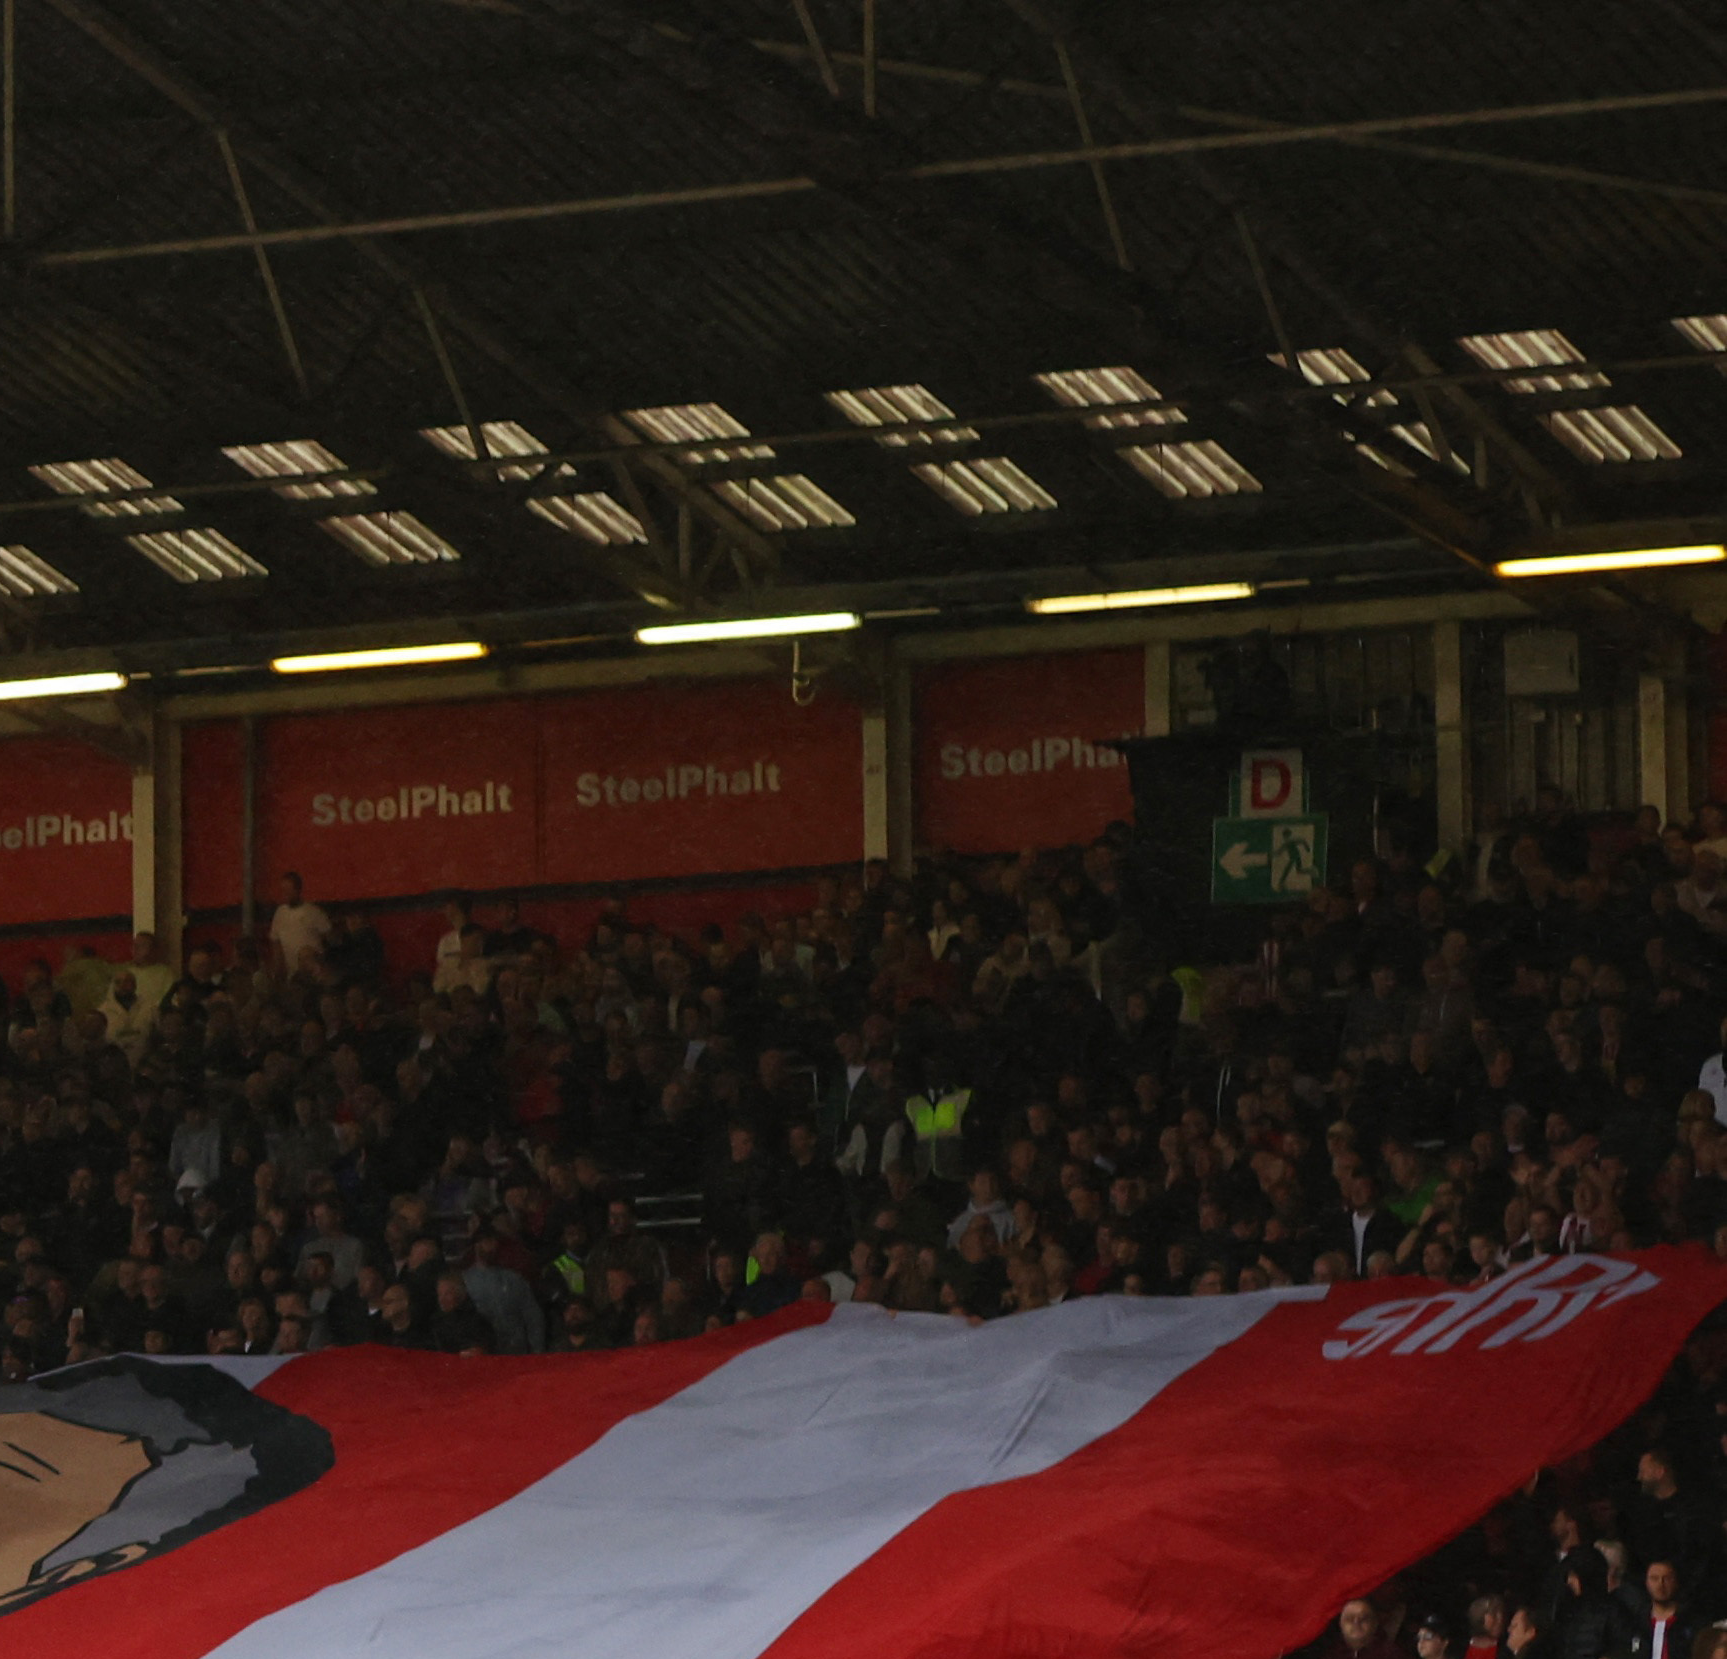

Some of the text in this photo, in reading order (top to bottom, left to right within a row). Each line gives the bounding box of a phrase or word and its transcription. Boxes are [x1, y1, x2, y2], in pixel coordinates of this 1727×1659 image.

[940, 731, 1135, 780] SteelPha
[311, 781, 513, 827] SteelPhalt
[576, 761, 781, 808] SteelPhalt
[1250, 760, 1292, 810] D
